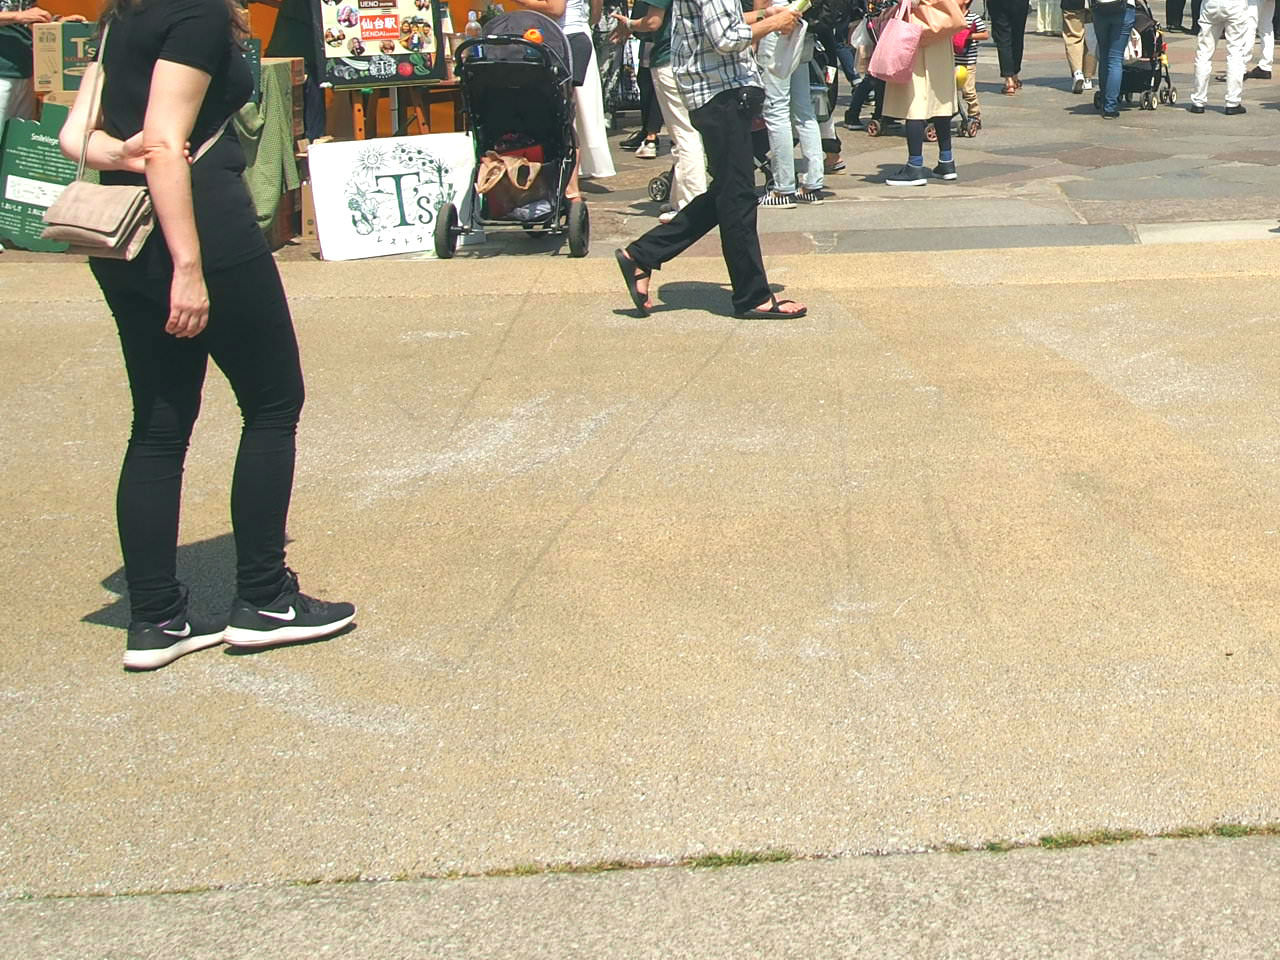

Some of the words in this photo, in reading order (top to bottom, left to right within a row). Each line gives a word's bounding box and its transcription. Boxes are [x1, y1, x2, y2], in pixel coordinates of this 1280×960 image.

[360, 0, 379, 8] UENO
[361, 17, 398, 29] 仙台駅
[69, 37, 97, 58] T's
[375, 171, 434, 228] T's
